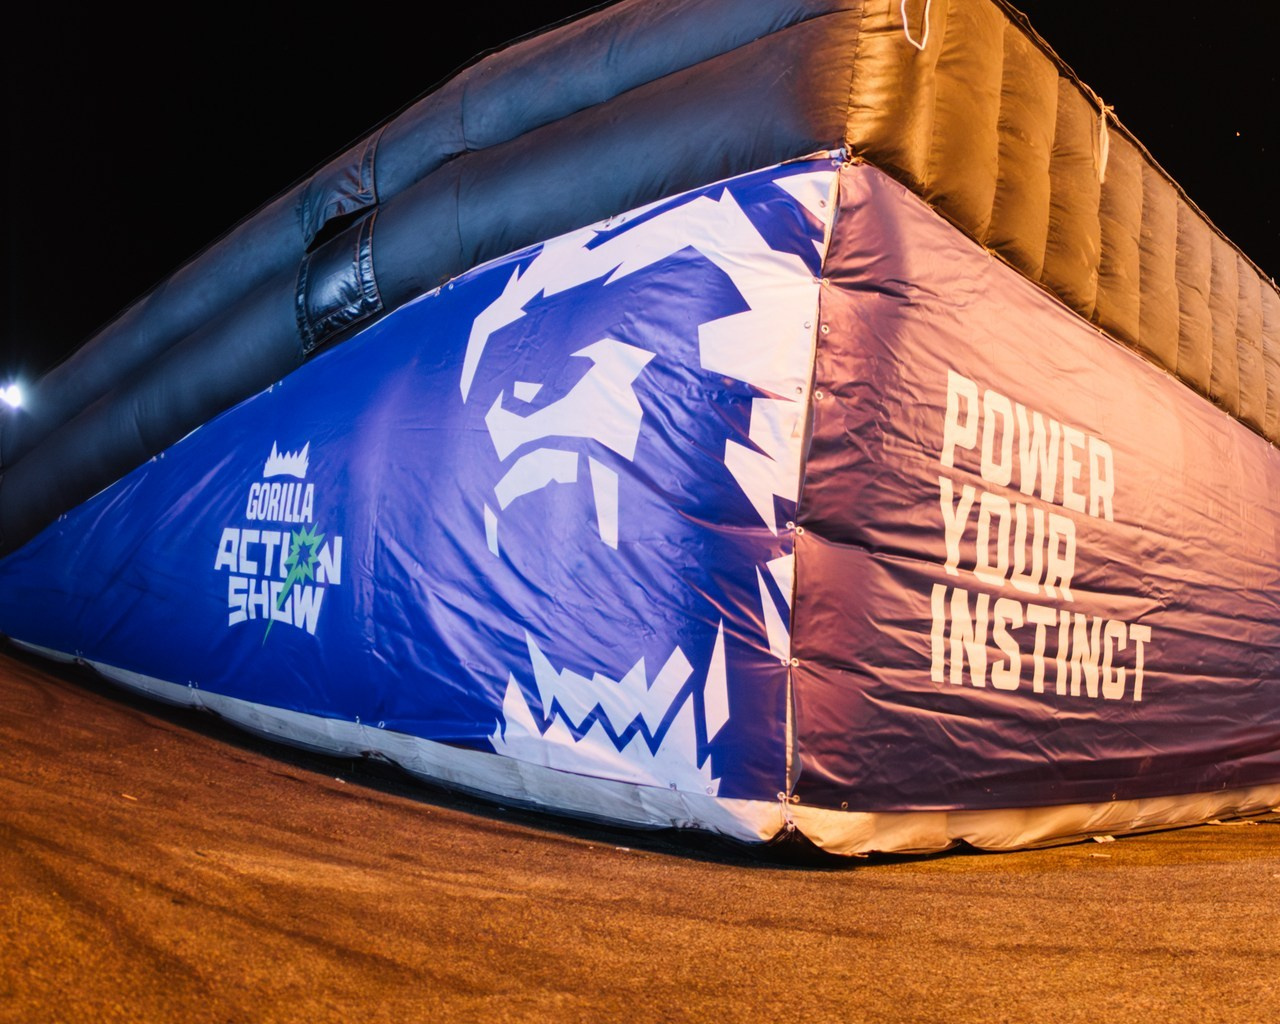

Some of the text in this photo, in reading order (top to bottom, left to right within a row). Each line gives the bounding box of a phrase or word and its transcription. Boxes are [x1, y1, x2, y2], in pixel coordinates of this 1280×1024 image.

[940, 370, 1115, 522] POWER
[246, 482, 314, 523] GORILLA
[938, 475, 1077, 602] YOUR
[214, 526, 342, 585] ACTION
[228, 575, 325, 635] SHOW
[930, 583, 1152, 702] INSTINCT
